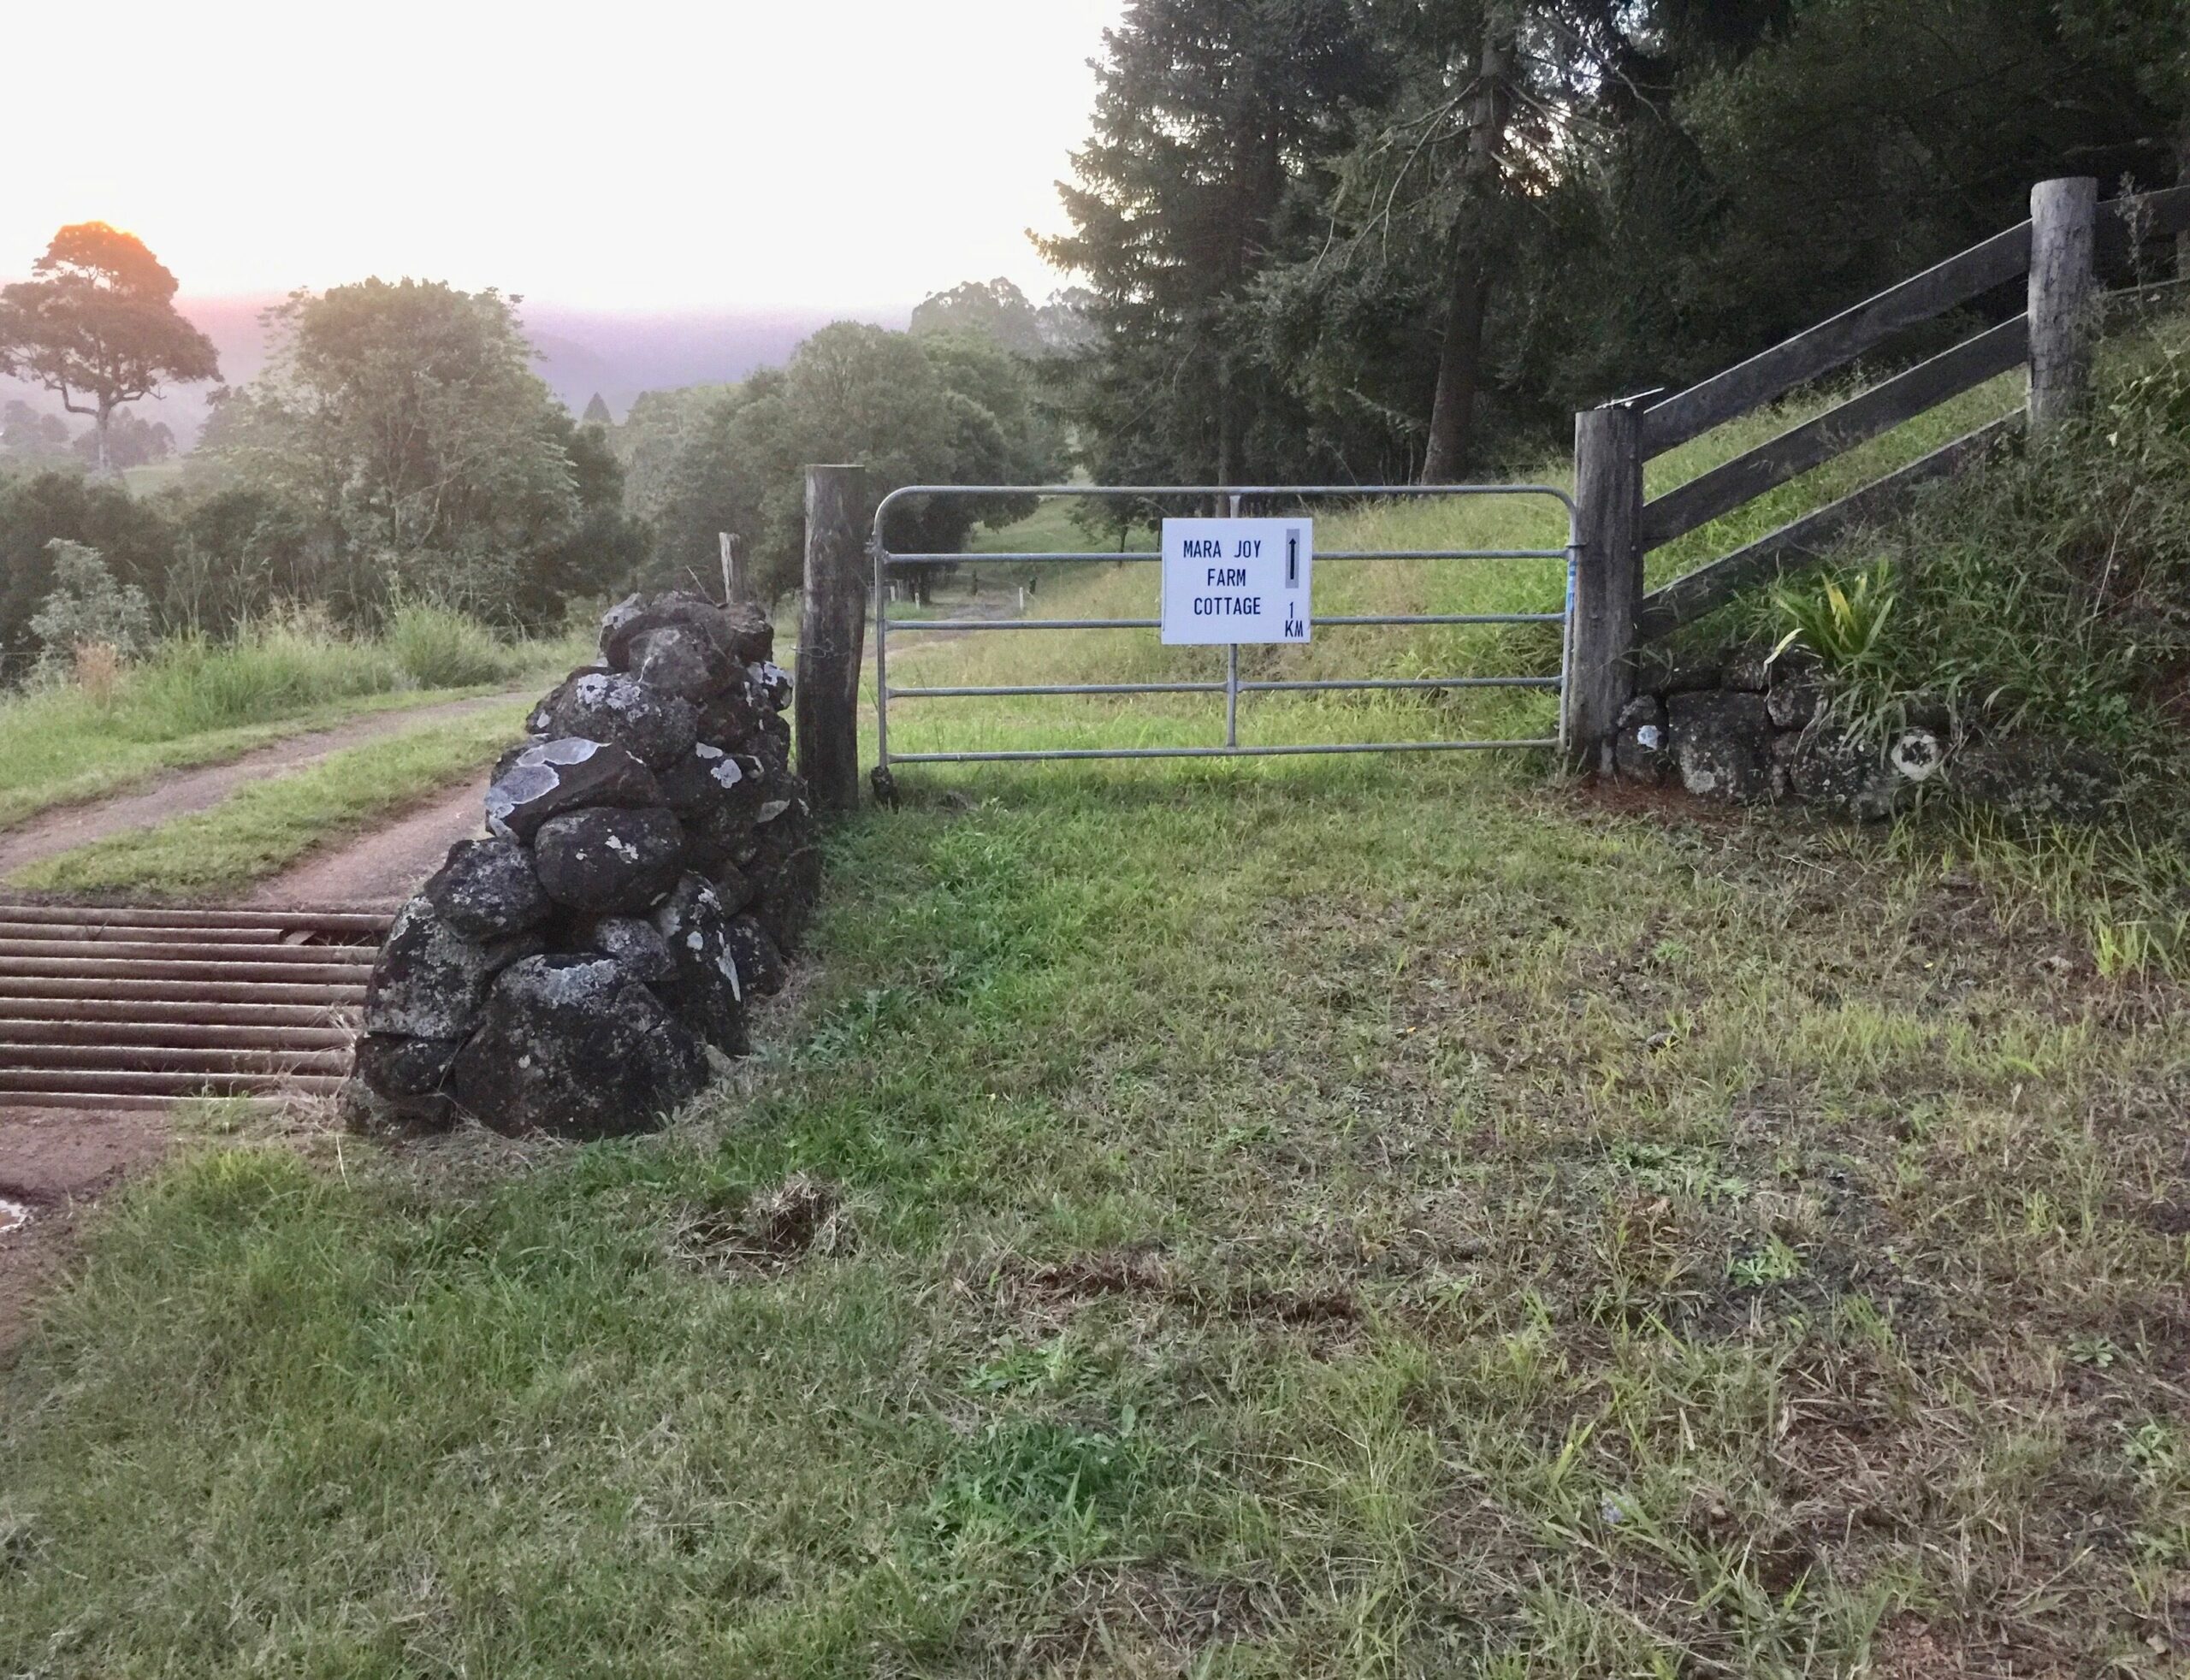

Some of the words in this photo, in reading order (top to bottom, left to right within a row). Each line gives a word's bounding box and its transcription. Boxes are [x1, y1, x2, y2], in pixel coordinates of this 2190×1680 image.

[1183, 540, 1222, 559] MARA
[1234, 540, 1262, 559] JOY
[1207, 569, 1246, 587] FARM
[1193, 597, 1261, 615] COTTAGE
[1289, 601, 1294, 618] 1
[1285, 620, 1304, 637] KM
